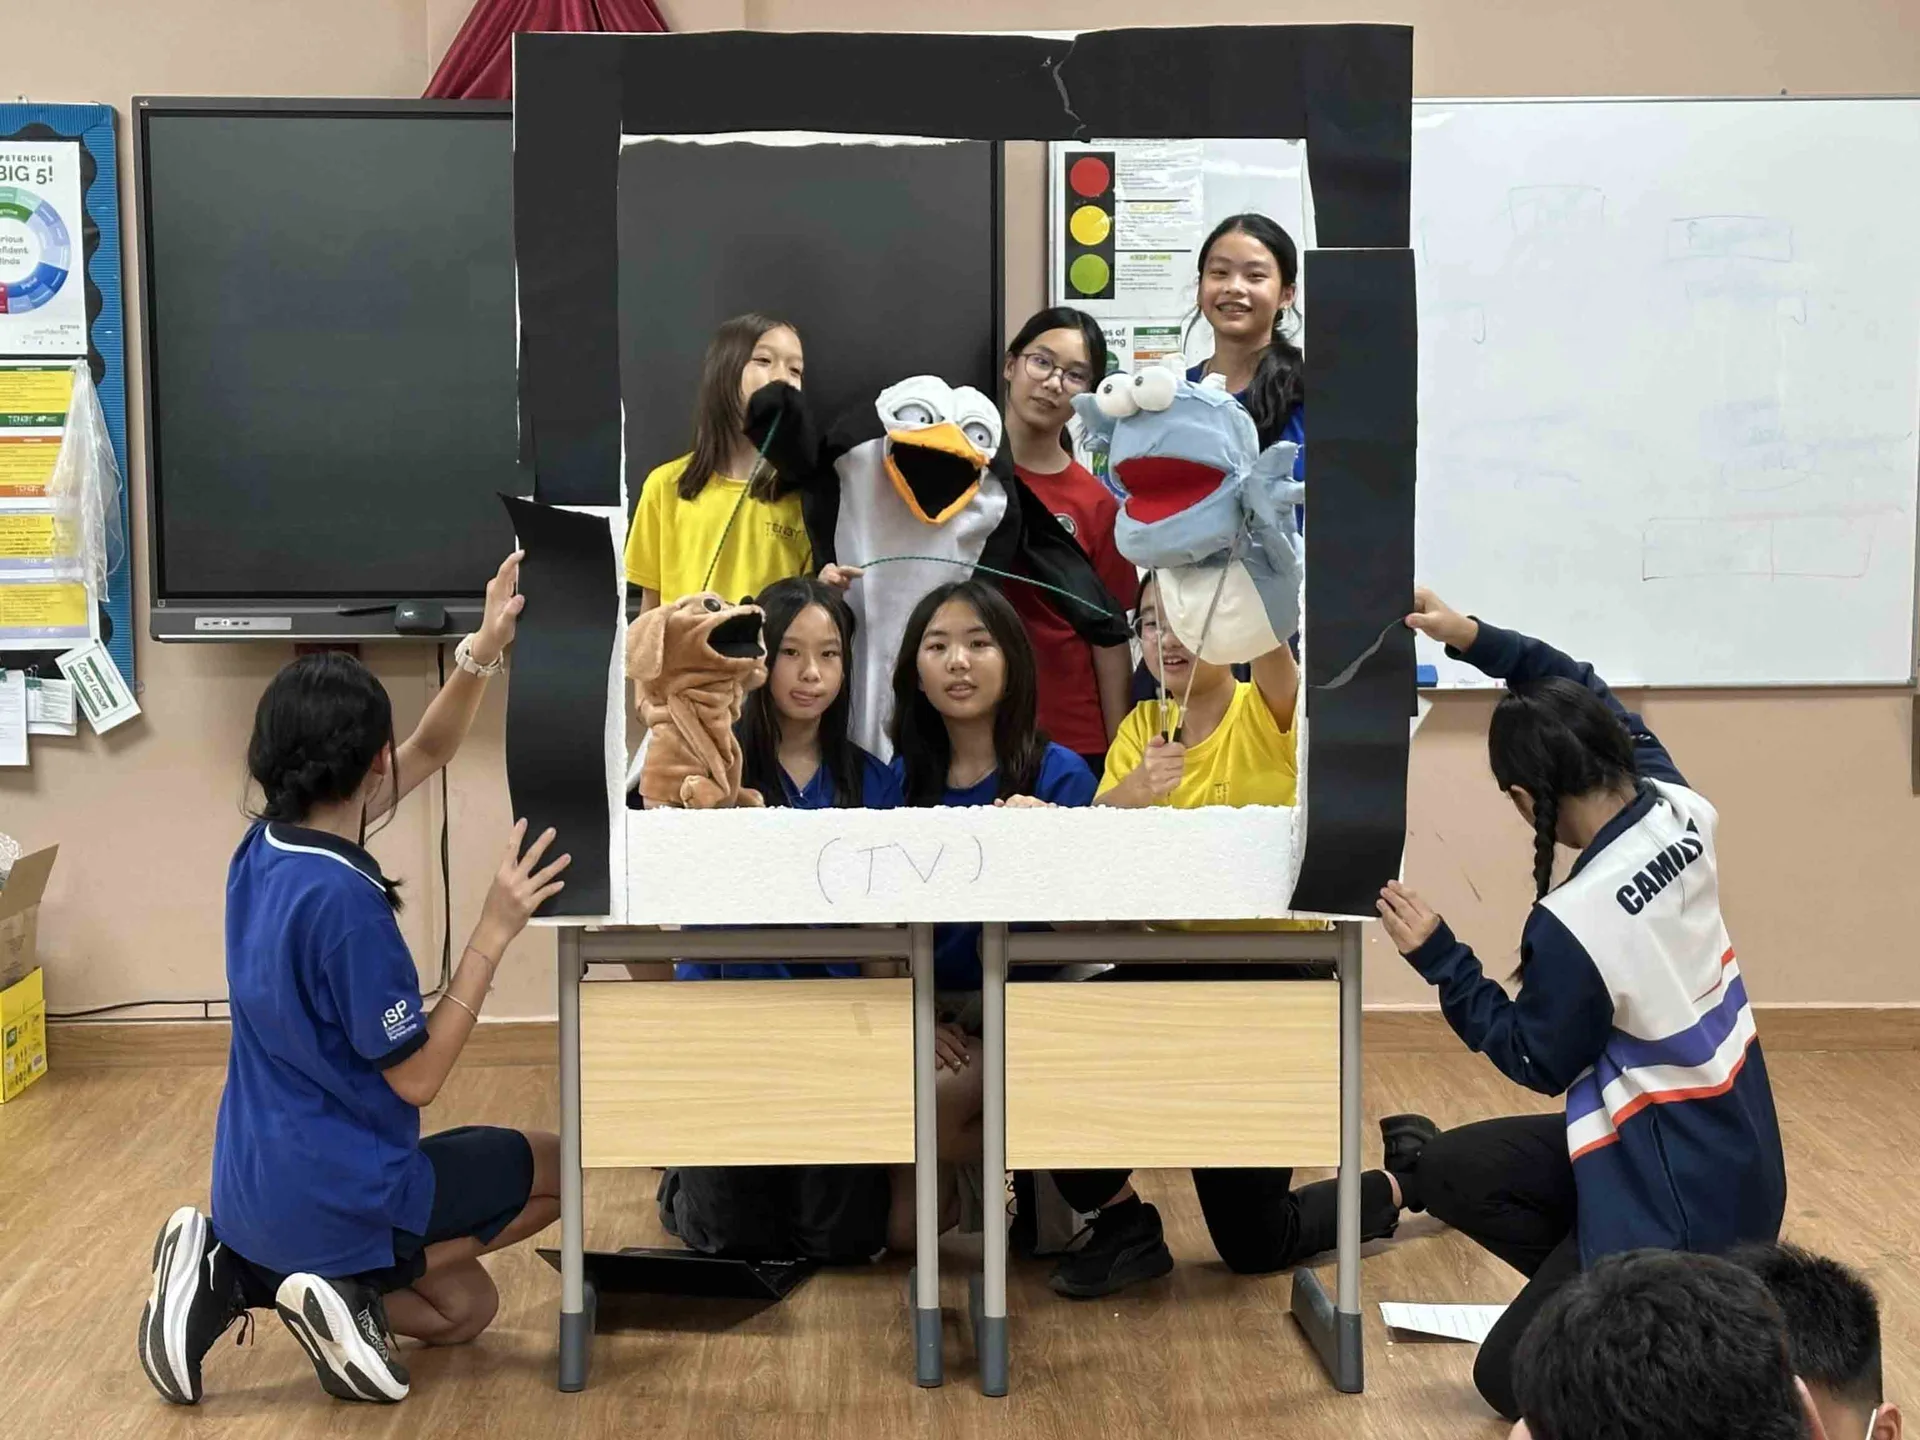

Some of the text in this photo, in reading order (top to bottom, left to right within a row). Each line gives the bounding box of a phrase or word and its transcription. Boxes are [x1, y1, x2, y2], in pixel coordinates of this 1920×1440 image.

[0, 165, 53, 185] BIG 5!
[1115, 327, 1126, 336] of
[817, 835, 983, 905] (TV)
